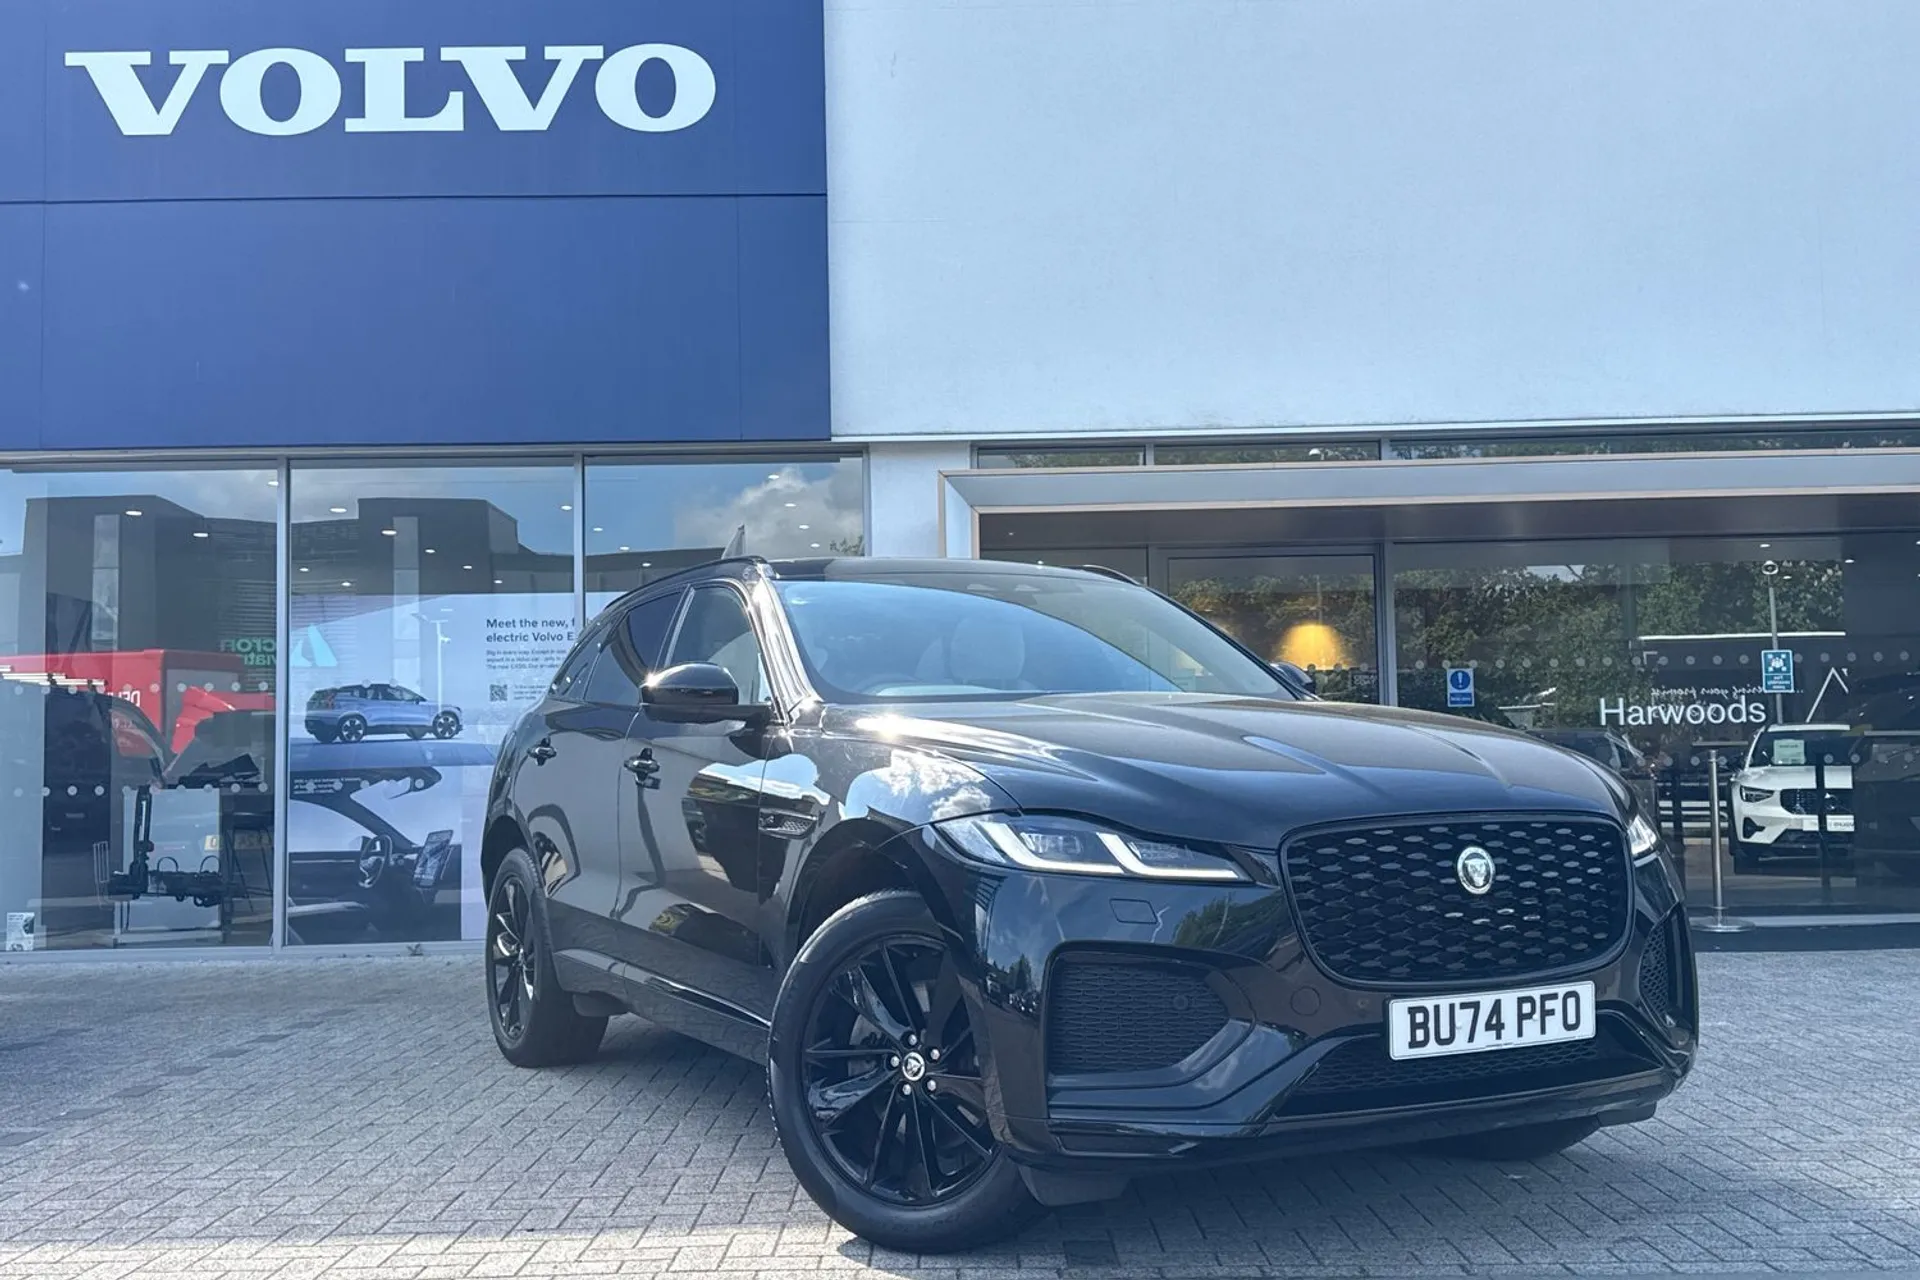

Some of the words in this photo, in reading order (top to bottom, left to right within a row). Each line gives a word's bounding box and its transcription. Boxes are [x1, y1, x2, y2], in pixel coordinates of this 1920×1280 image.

[65, 43, 716, 136] VOLVO
[486, 618, 516, 628] Meet
[519, 618, 538, 628] the
[541, 619, 569, 629] new,
[486, 632, 529, 643] electric
[532, 631, 564, 642] Volvo
[1600, 694, 1767, 726] Harwoods
[1407, 998, 1505, 1050] BU74
[1516, 990, 1581, 1038] PFO
